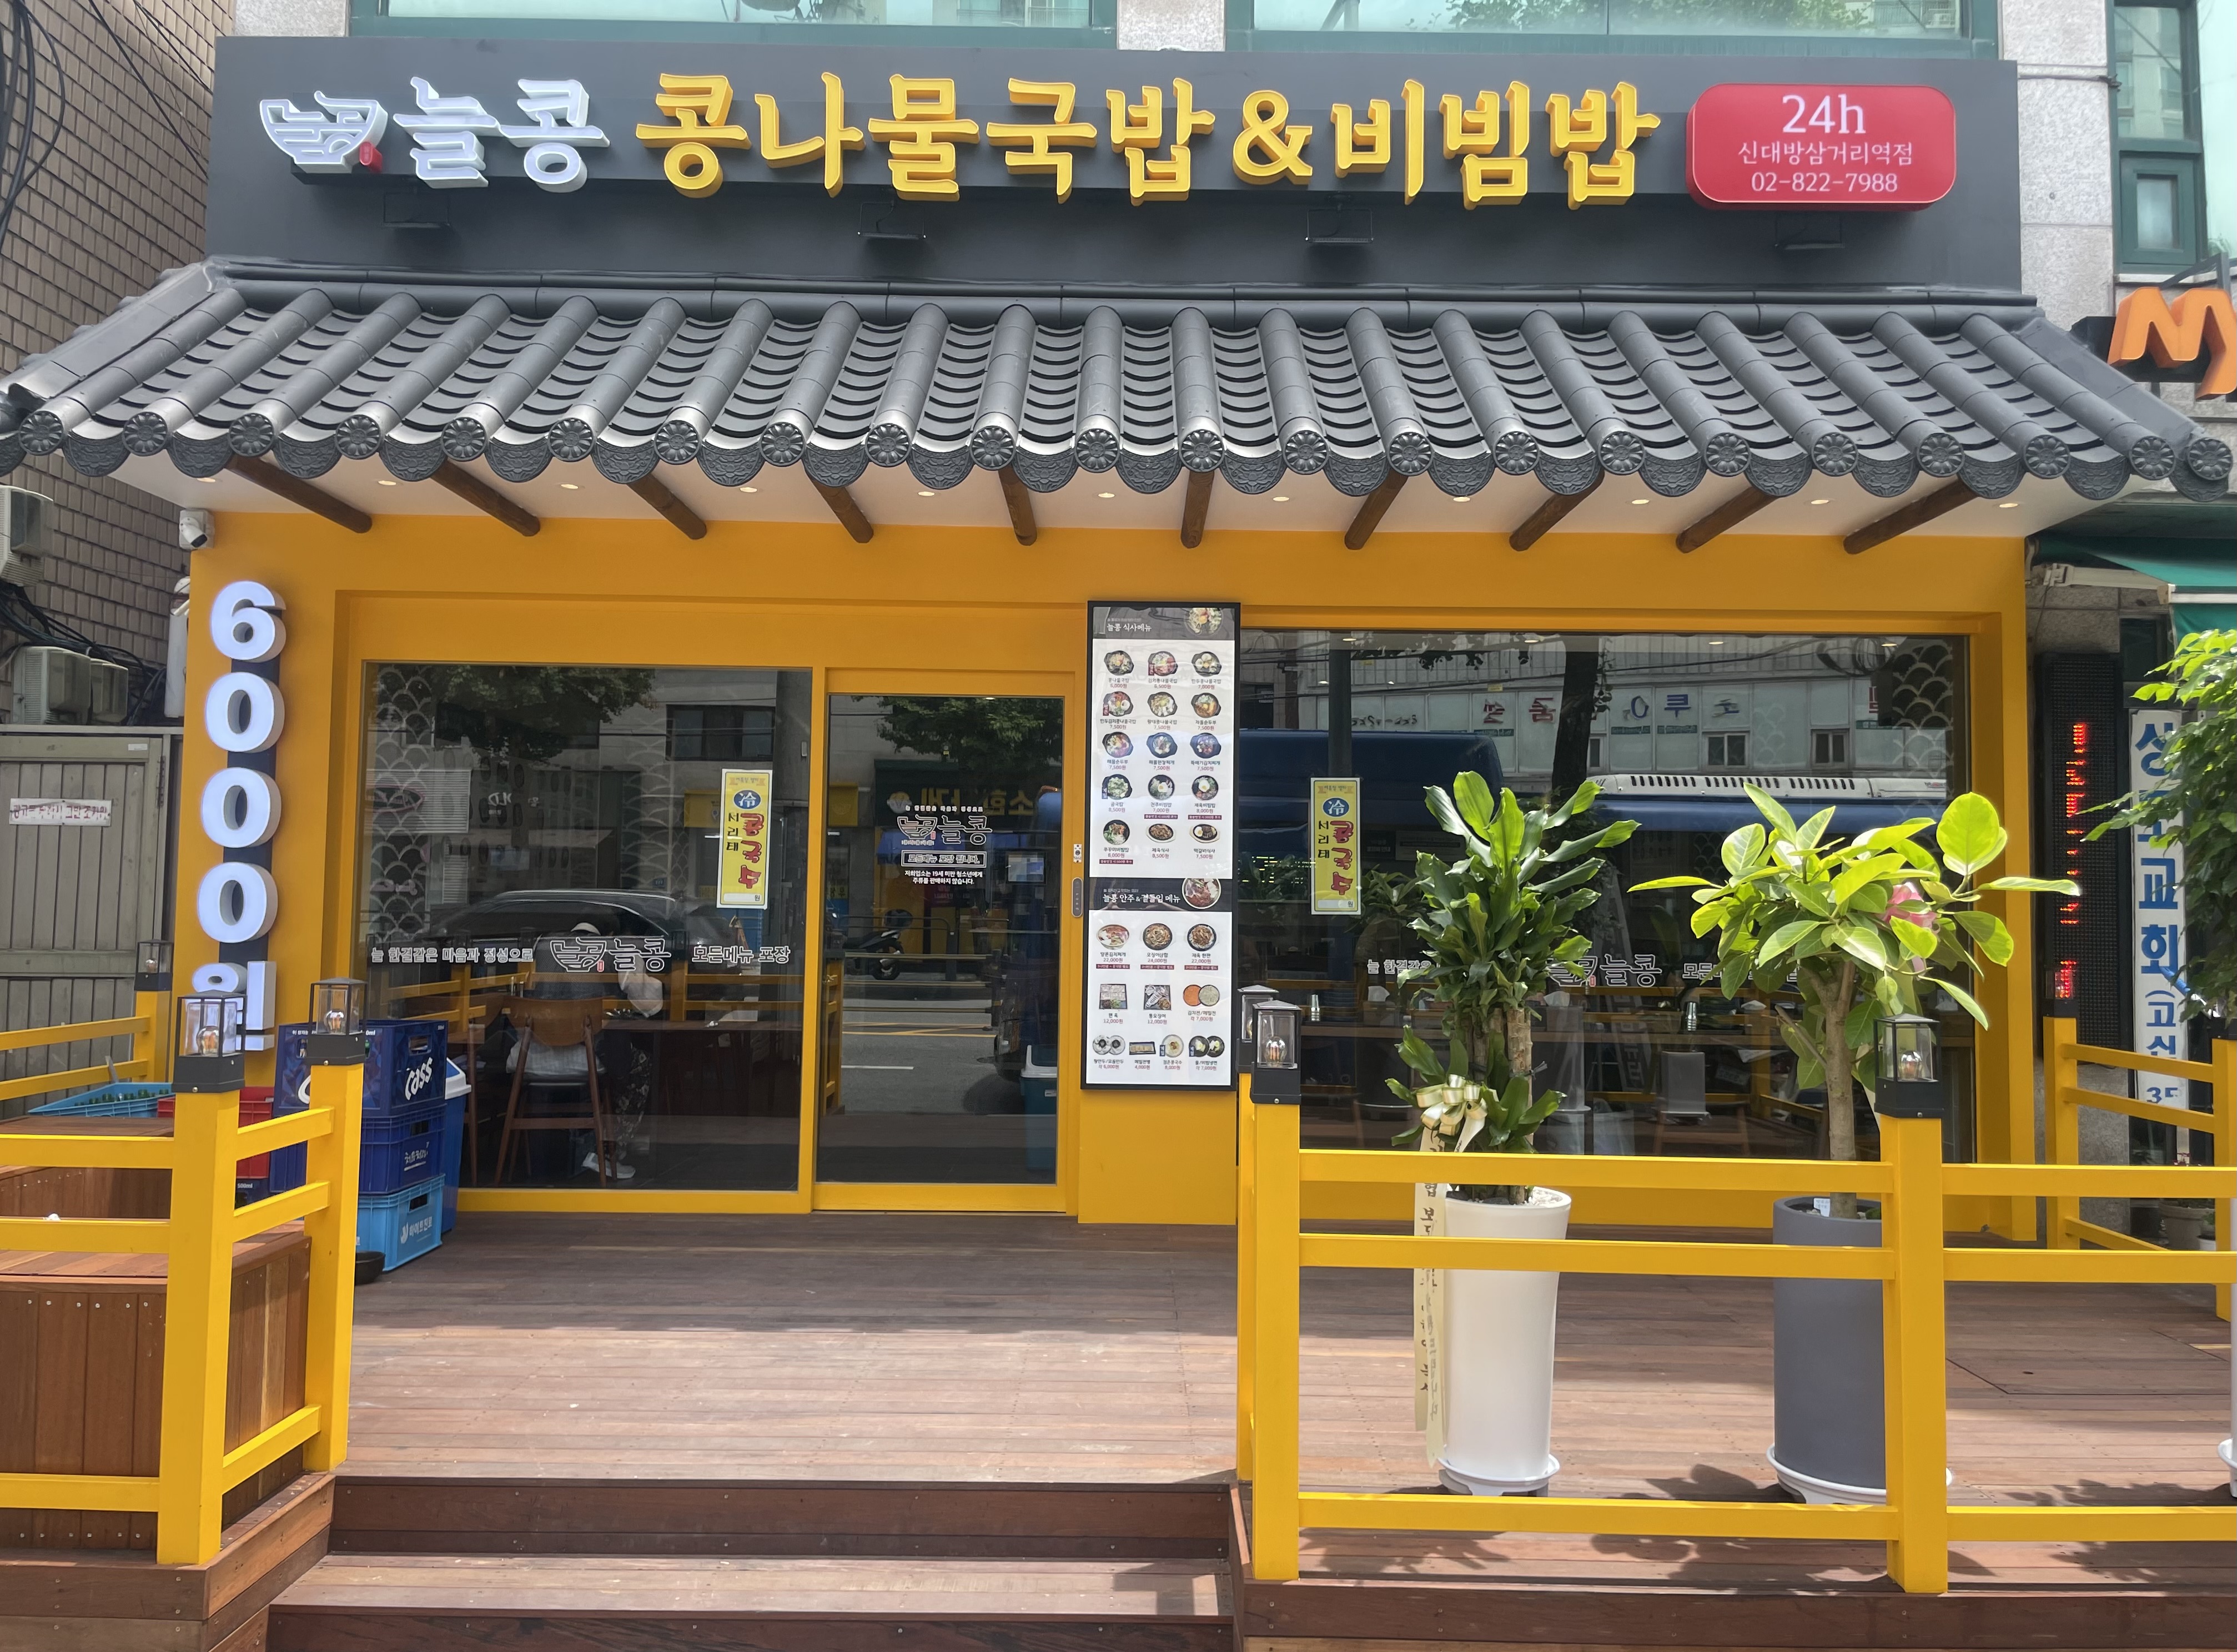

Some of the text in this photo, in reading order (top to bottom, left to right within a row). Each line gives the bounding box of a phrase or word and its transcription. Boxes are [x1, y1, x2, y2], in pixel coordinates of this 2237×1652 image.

[1782, 94, 1866, 134] 24h
[394, 77, 609, 193] 늘콩
[1738, 142, 1913, 166] 신대방삼거리역점
[1751, 172, 1898, 192] 02-822-7988
[1107, 623, 1152, 632] 늘콩 식사메뉴
[738, 792, 757, 808] 冷
[1328, 800, 1346, 815] 冷
[726, 813, 740, 851] 서리태
[937, 815, 993, 845] 늘콩
[1318, 820, 1330, 858] 서리태
[738, 813, 765, 889] 콩국수
[908, 854, 981, 864] 모든메뉴 포장 됩니다.
[1330, 820, 1354, 895] 콩국수
[1103, 893, 1118, 903] 늘콩
[1119, 893, 1135, 903] 안주
[1142, 893, 1163, 903] 곁들임
[1165, 894, 1181, 904] 메뉴
[371, 947, 534, 963] 늘 한결같은 마음과 정성으로
[608, 938, 672, 971] 늘콩
[691, 946, 791, 964] 모든메뉴 포장
[1367, 959, 1380, 974] 늘
[1600, 953, 1662, 988] 늘콩
[409, 1216, 433, 1237] 하이트진로
